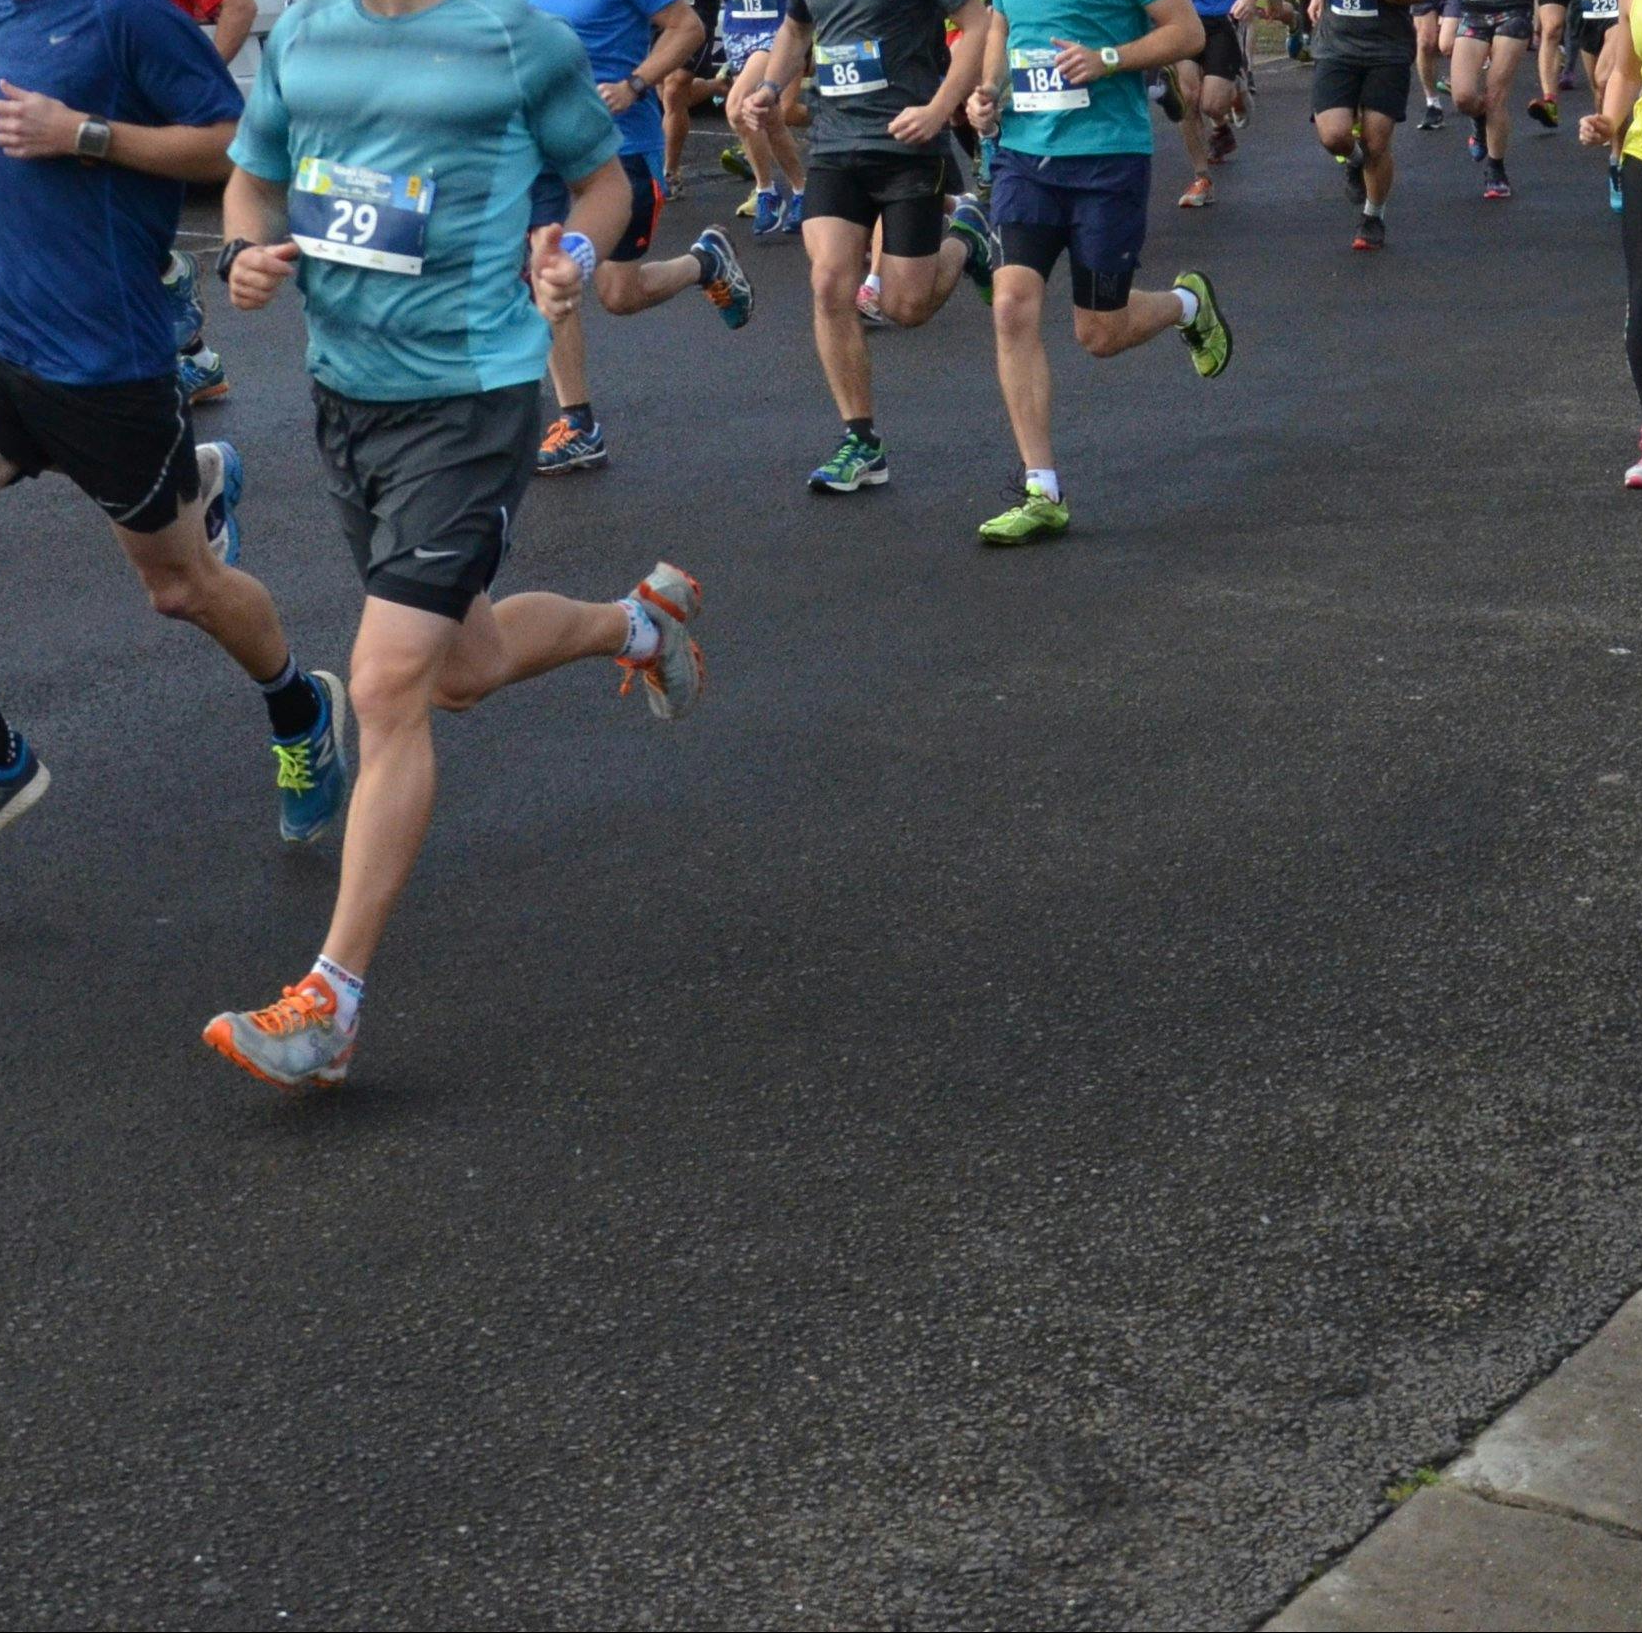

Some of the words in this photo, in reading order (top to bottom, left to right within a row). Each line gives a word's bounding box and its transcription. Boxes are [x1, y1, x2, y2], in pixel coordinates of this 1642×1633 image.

[832, 61, 860, 85] 86
[1026, 68, 1063, 92] 184
[325, 199, 378, 245] 29
